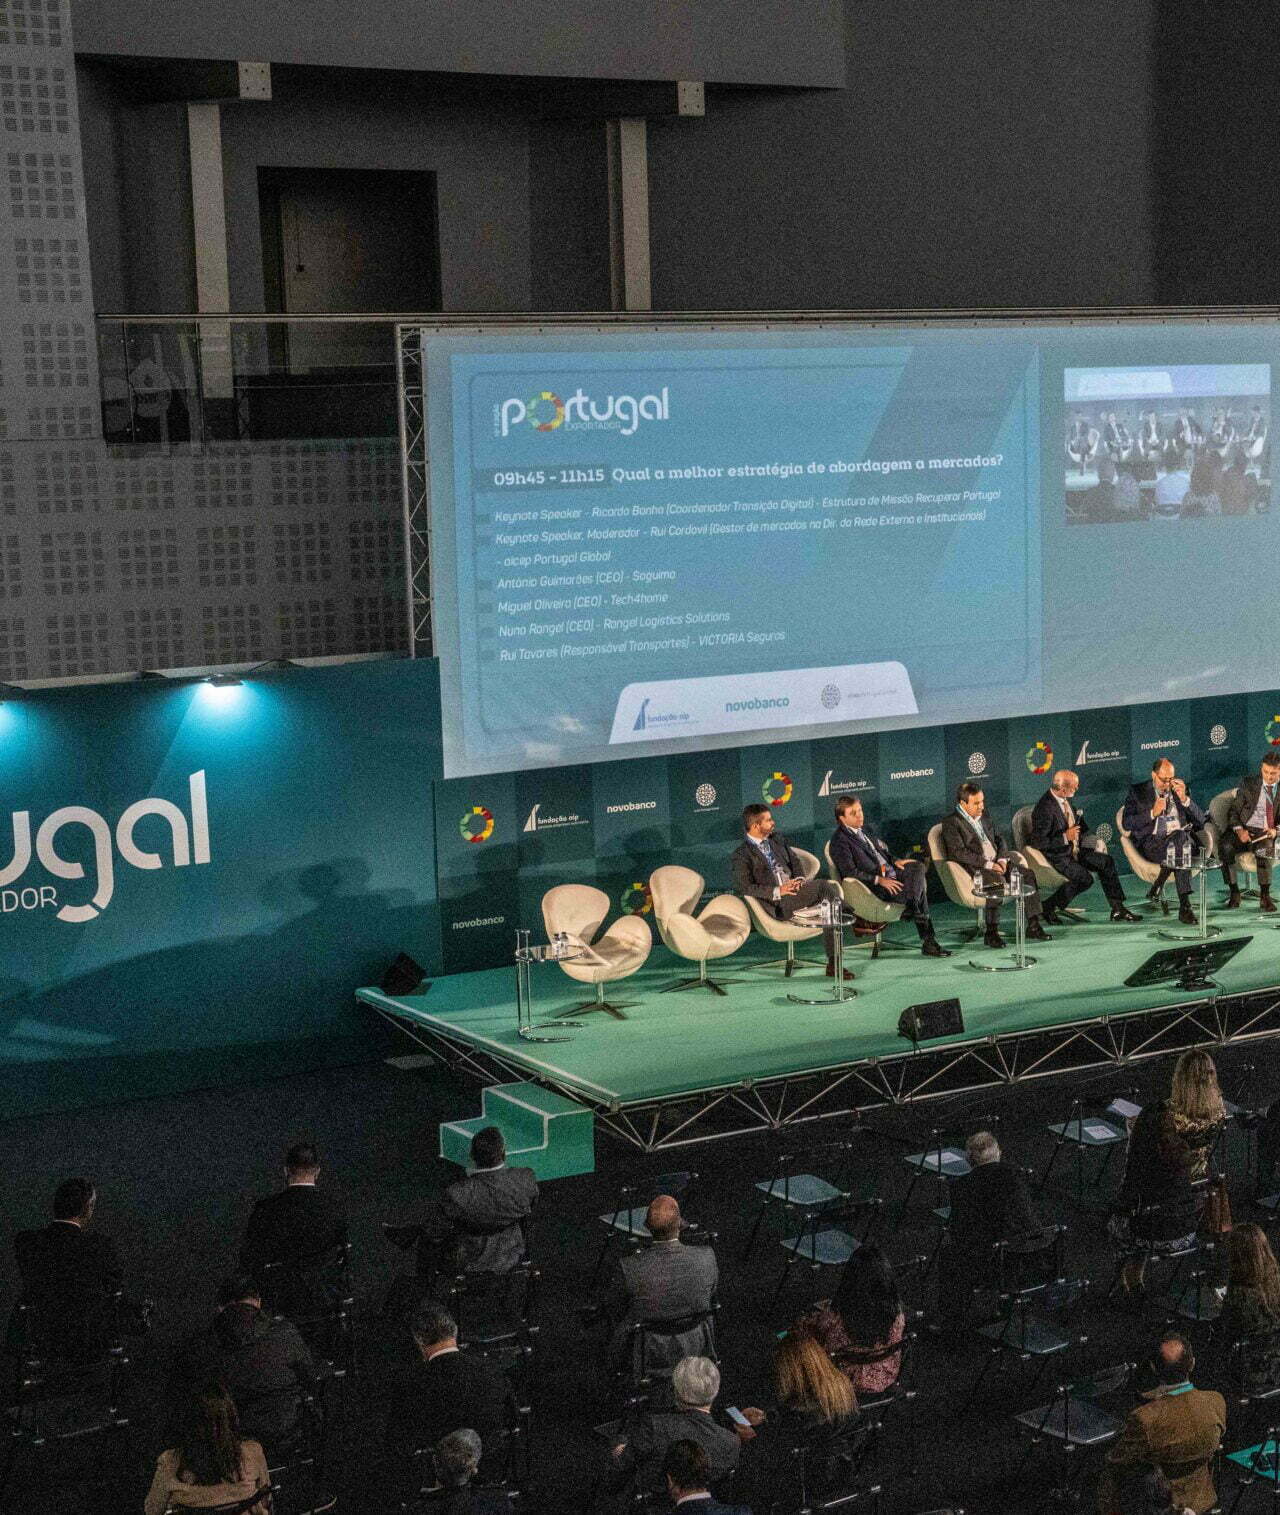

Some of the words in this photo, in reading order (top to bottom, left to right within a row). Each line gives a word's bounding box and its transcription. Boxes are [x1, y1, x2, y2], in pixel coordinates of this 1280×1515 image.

[494, 470, 546, 487] 09h45
[560, 468, 605, 484] 11h15
[612, 467, 650, 484] Qual
[654, 469, 665, 481] a
[668, 464, 722, 480] melhor
[727, 461, 803, 479] estratégia
[806, 461, 825, 474] de
[829, 458, 912, 475] abordagem
[916, 459, 925, 470] a
[928, 454, 1004, 470] mercados?
[495, 510, 539, 525] Keynote
[540, 508, 582, 522] Speaker
[591, 505, 630, 517] Ricardo
[732, 499, 777, 513] Transição
[822, 497, 866, 509] Estrutura
[867, 496, 880, 506] de
[880, 494, 914, 506] Missão
[916, 492, 962, 506] Recuperar
[962, 489, 1001, 503] Portugal
[495, 532, 539, 546] Keynote
[586, 528, 641, 541] Moderador
[650, 526, 666, 537] Rui
[746, 521, 760, 532] de
[760, 519, 808, 532] mercados
[878, 514, 915, 527] Externa
[533, 551, 577, 566] Portugal
[579, 550, 612, 563] Global
[498, 576, 538, 589] António
[540, 573, 593, 587] Guimarães
[498, 600, 532, 615] Miguel
[534, 598, 572, 612] Oliveira
[499, 624, 527, 637] Nuno
[529, 621, 564, 636] Rangel
[603, 616, 638, 631] Rangel
[639, 614, 683, 629] Logistics
[684, 611, 731, 625] Solutions
[500, 648, 517, 662] Rui
[519, 646, 559, 660] Tavares
[698, 632, 746, 647] VICTORIA
[747, 630, 786, 645] Seguros
[725, 694, 791, 713] novobanco
[1140, 739, 1181, 751] novobanco
[890, 768, 935, 781] novobanco
[607, 800, 657, 814] novobanco
[538, 815, 568, 827] fundação
[0, 885, 58, 913] DOR
[452, 914, 505, 931] novobanco
